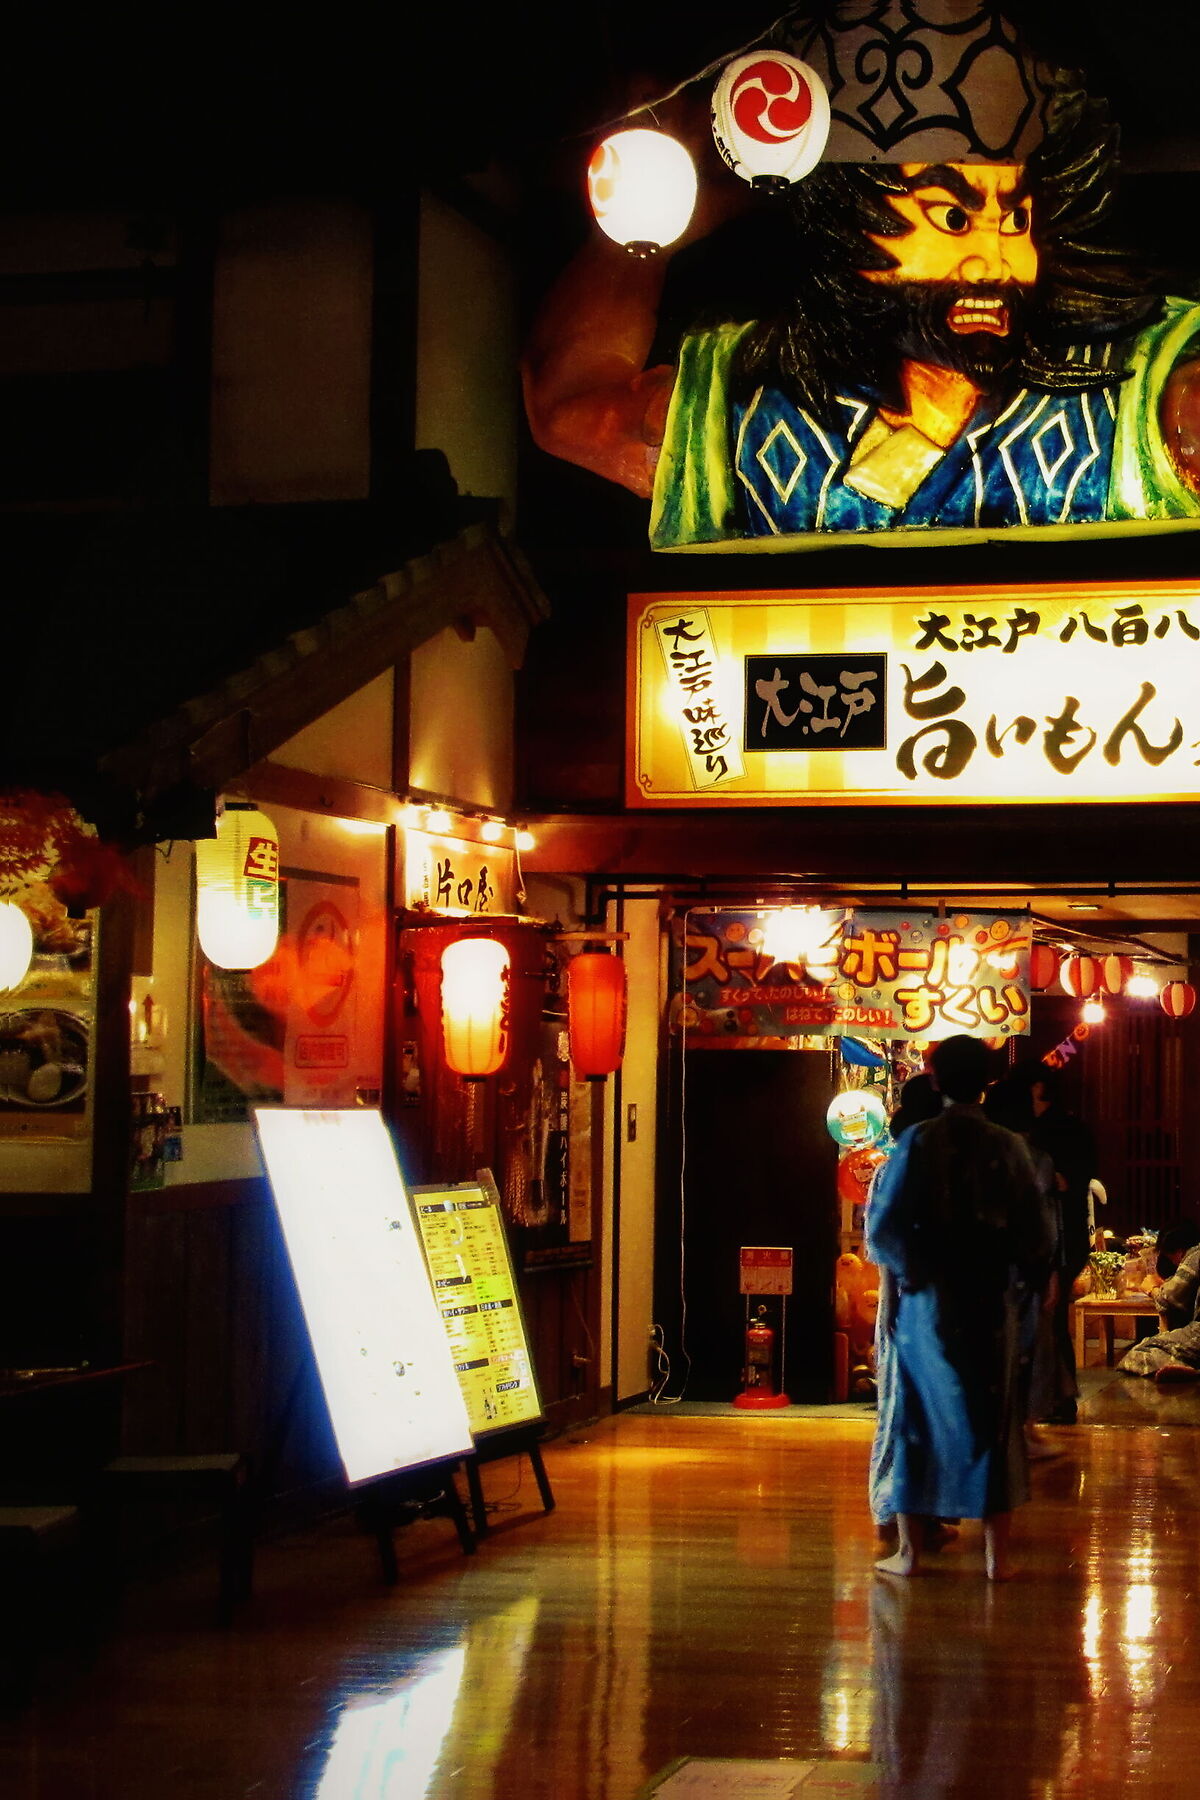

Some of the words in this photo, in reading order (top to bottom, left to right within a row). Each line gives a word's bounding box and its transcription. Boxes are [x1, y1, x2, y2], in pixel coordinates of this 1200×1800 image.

[915, 613, 1044, 654] 大江戸
[663, 617, 729, 783] 大江戸味巡り
[754, 666, 881, 740] 大江戸
[894, 985, 1030, 1032] すくい
